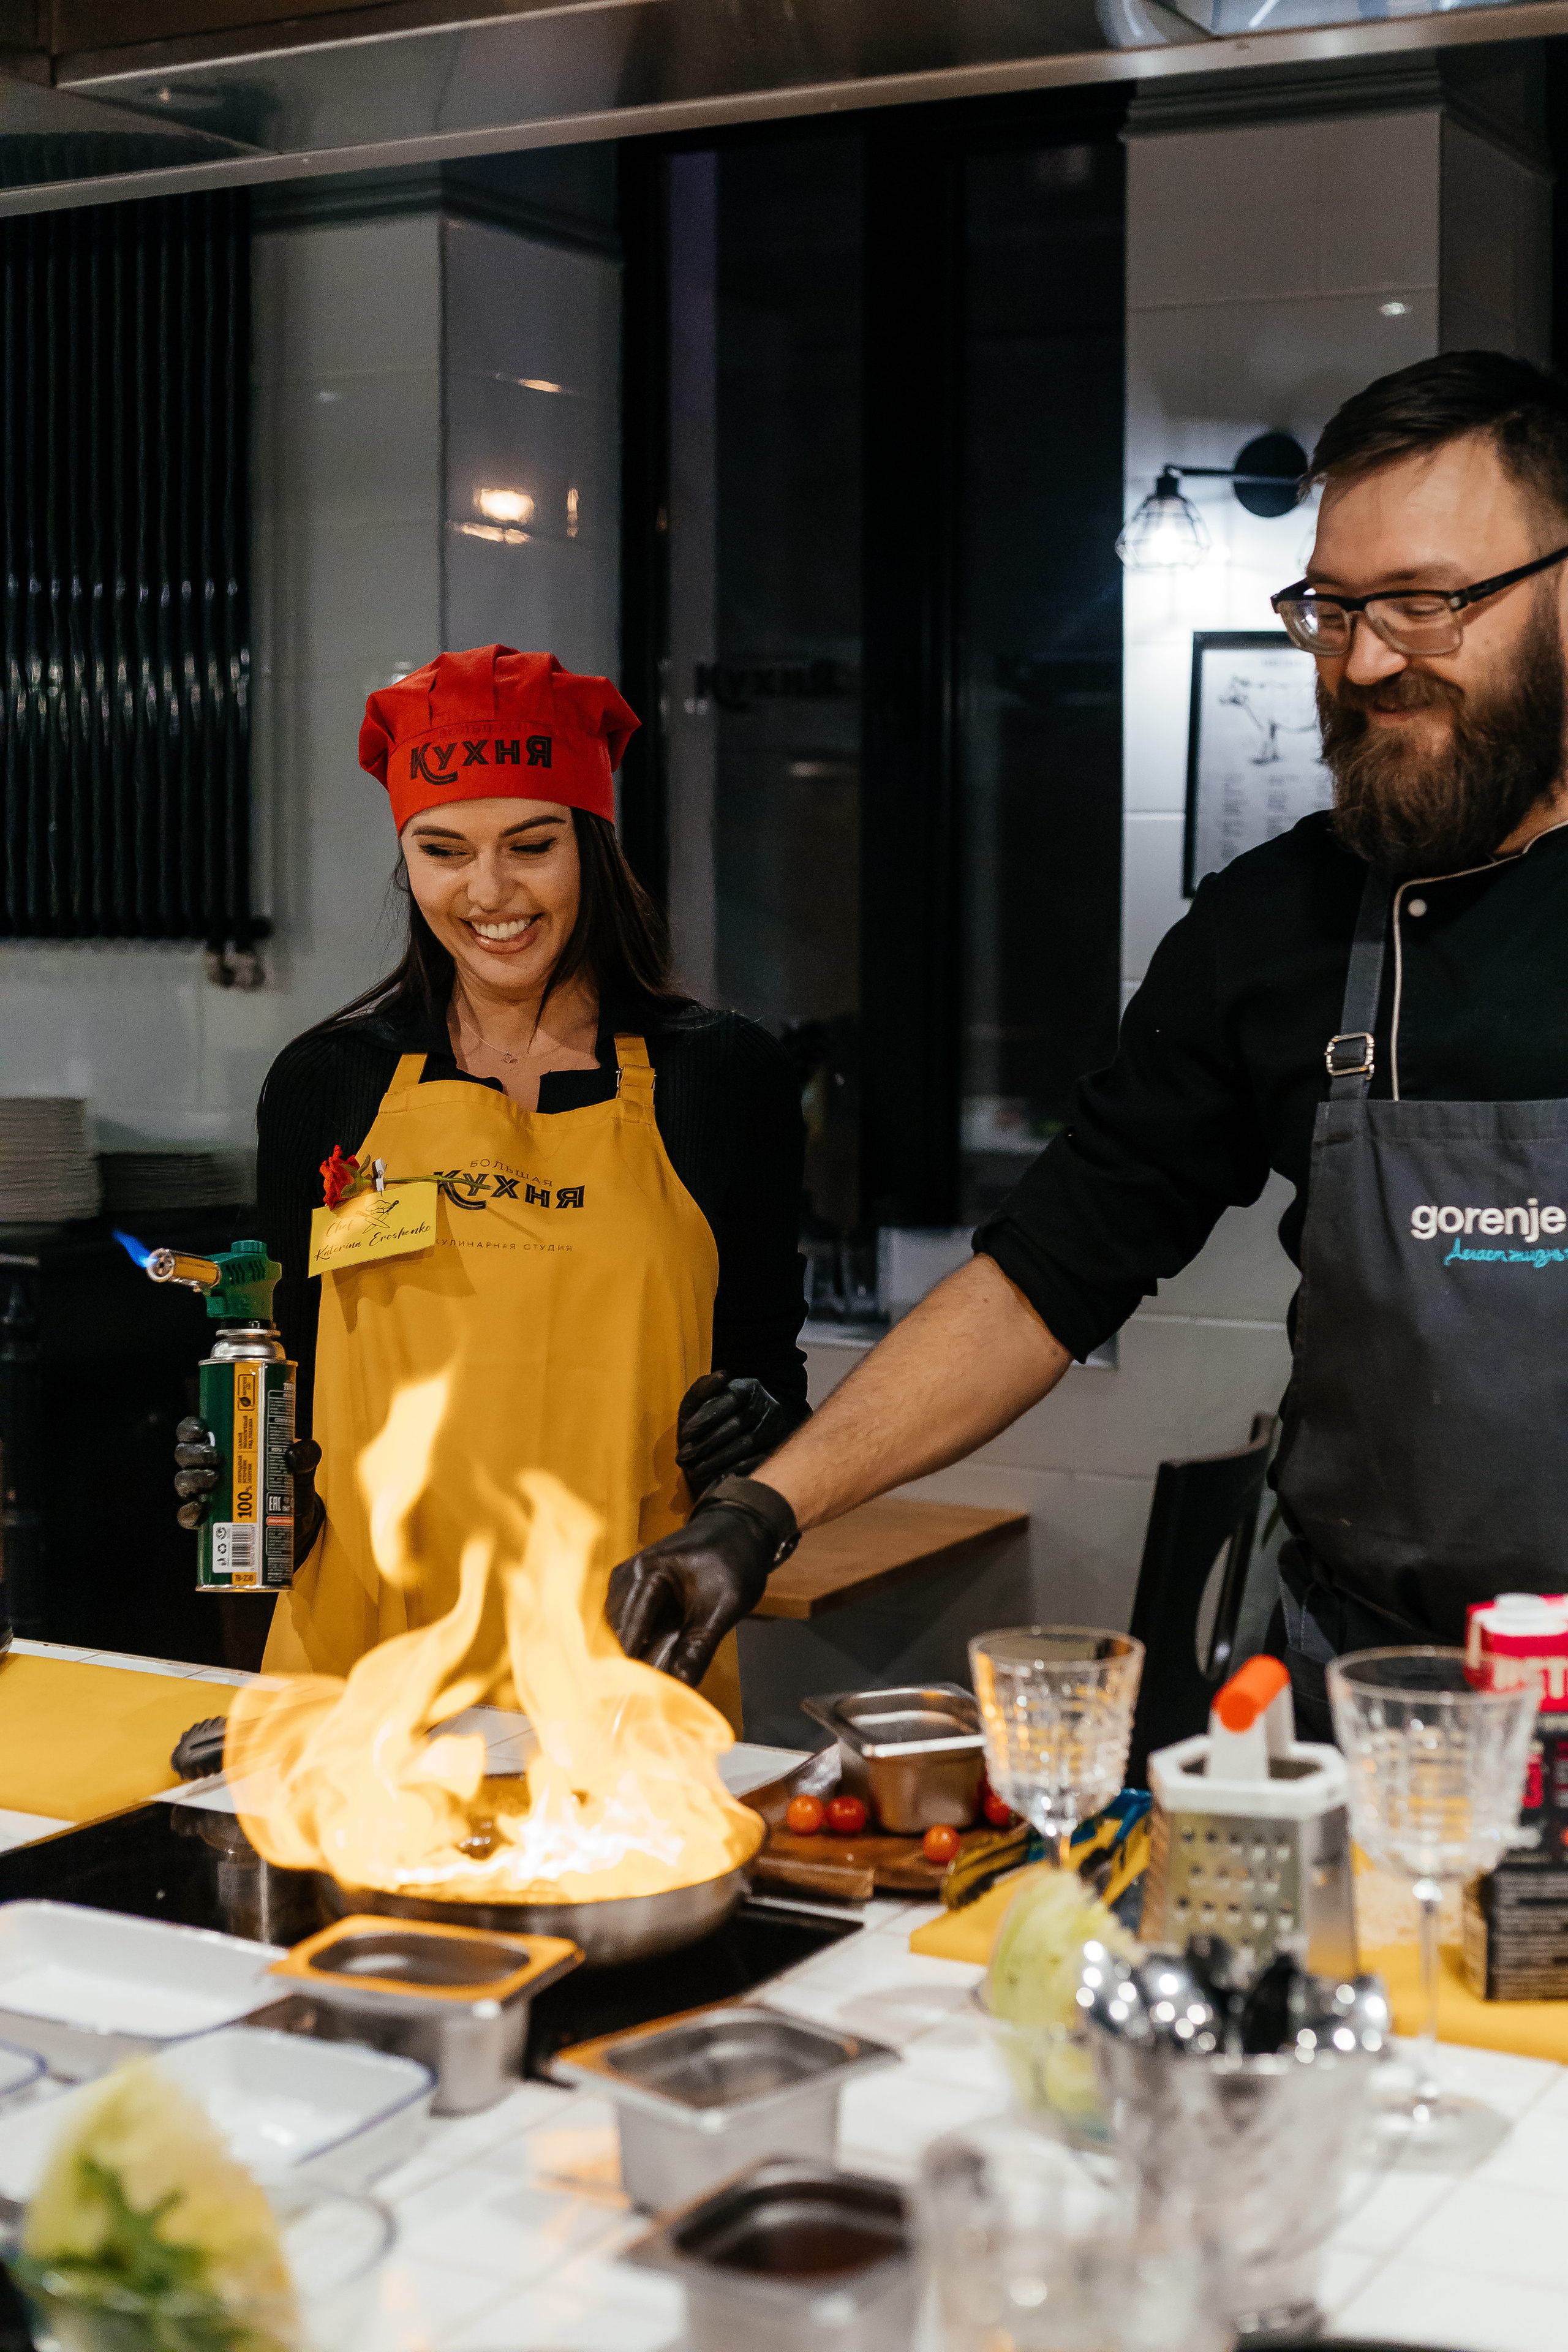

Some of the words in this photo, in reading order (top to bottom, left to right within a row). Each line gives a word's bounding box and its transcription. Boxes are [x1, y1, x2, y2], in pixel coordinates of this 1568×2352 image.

[410, 736, 552, 785] КУХНЯ
[434, 1169, 585, 1210] КУХНЯ
[469, 1158, 553, 1187] БОЛЬШАЯ
[326, 1219, 355, 1237] Chef
[1411, 1197, 1567, 1243] gorenje
[314, 1240, 362, 1262] Katerina
[369, 1221, 431, 1247] Eroshenko
[523, 1243, 573, 1251] СТУДИЯ
[237, 1485, 252, 1518] 100%
